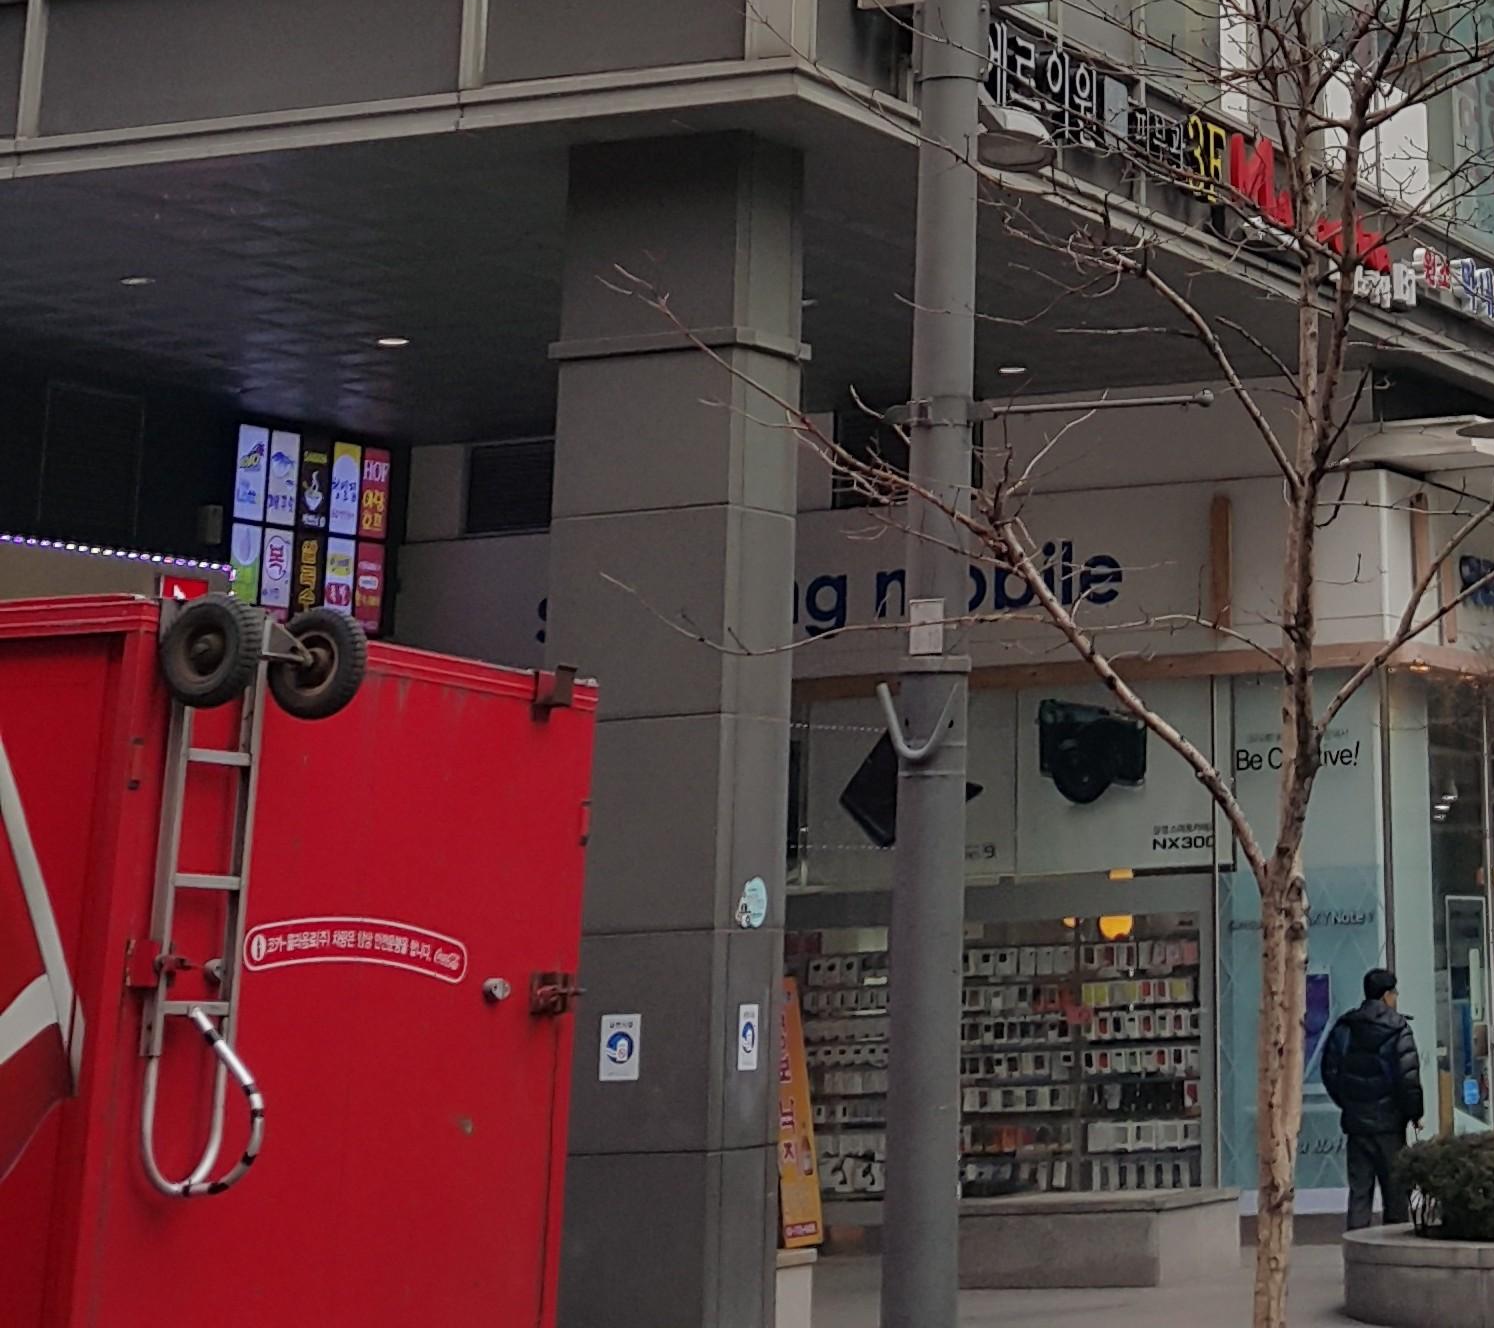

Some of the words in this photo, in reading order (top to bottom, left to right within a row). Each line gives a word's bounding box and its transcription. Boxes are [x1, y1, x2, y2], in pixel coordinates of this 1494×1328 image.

[1133, 106, 1188, 172] 피부과
[1187, 113, 1227, 204] 3F
[363, 459, 390, 483] HOF
[1236, 749, 1262, 771] Be
